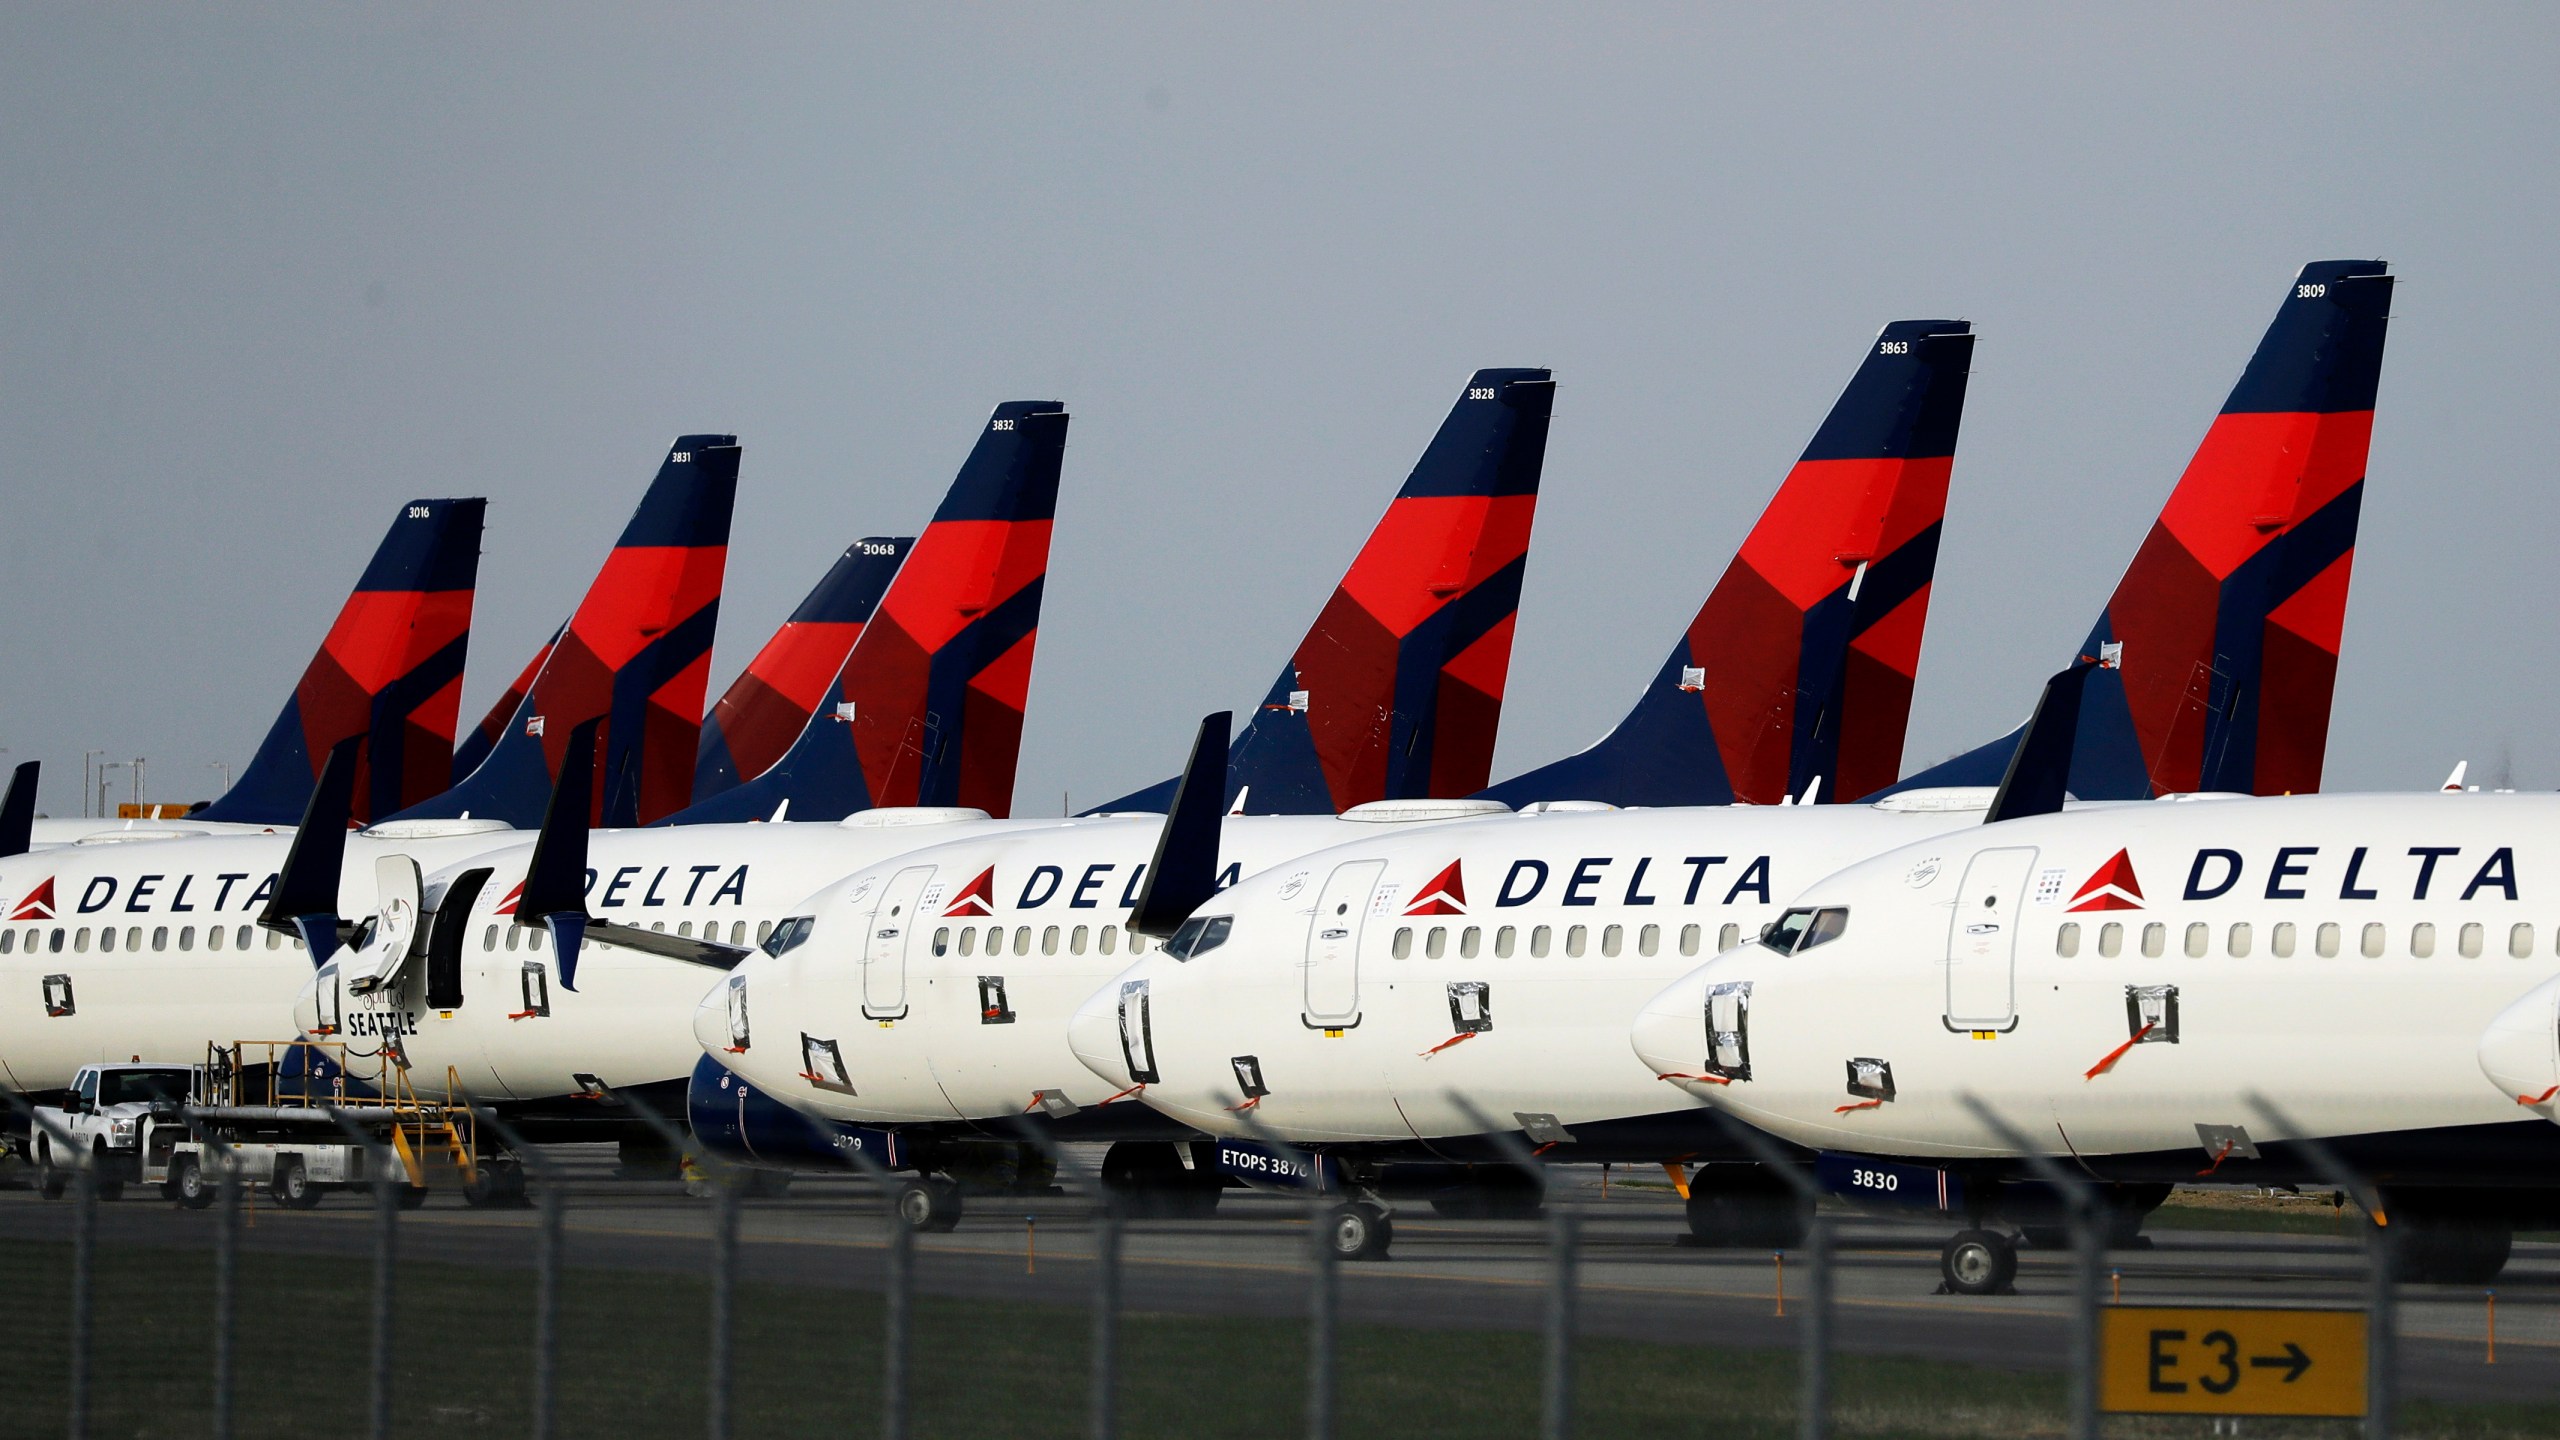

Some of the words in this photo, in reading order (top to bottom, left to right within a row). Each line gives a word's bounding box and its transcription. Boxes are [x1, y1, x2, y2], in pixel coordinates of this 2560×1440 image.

[2297, 284, 2326, 298] 3809
[1879, 341, 1908, 355] 3863
[1469, 387, 1495, 400] 3828
[992, 419, 1014, 431] 3832
[672, 451, 691, 463] 3831
[408, 506, 430, 519] 3016
[863, 544, 895, 556] 3068
[1495, 855, 1771, 908] DELTA
[2182, 847, 2519, 901] DELTA
[584, 864, 750, 908] ELTA
[348, 1011, 418, 1037] SEATTLE
[1222, 1148, 1267, 1172] ETOPS
[1852, 1168, 1898, 1192] 3830
[2149, 1329, 2240, 1395] E3
